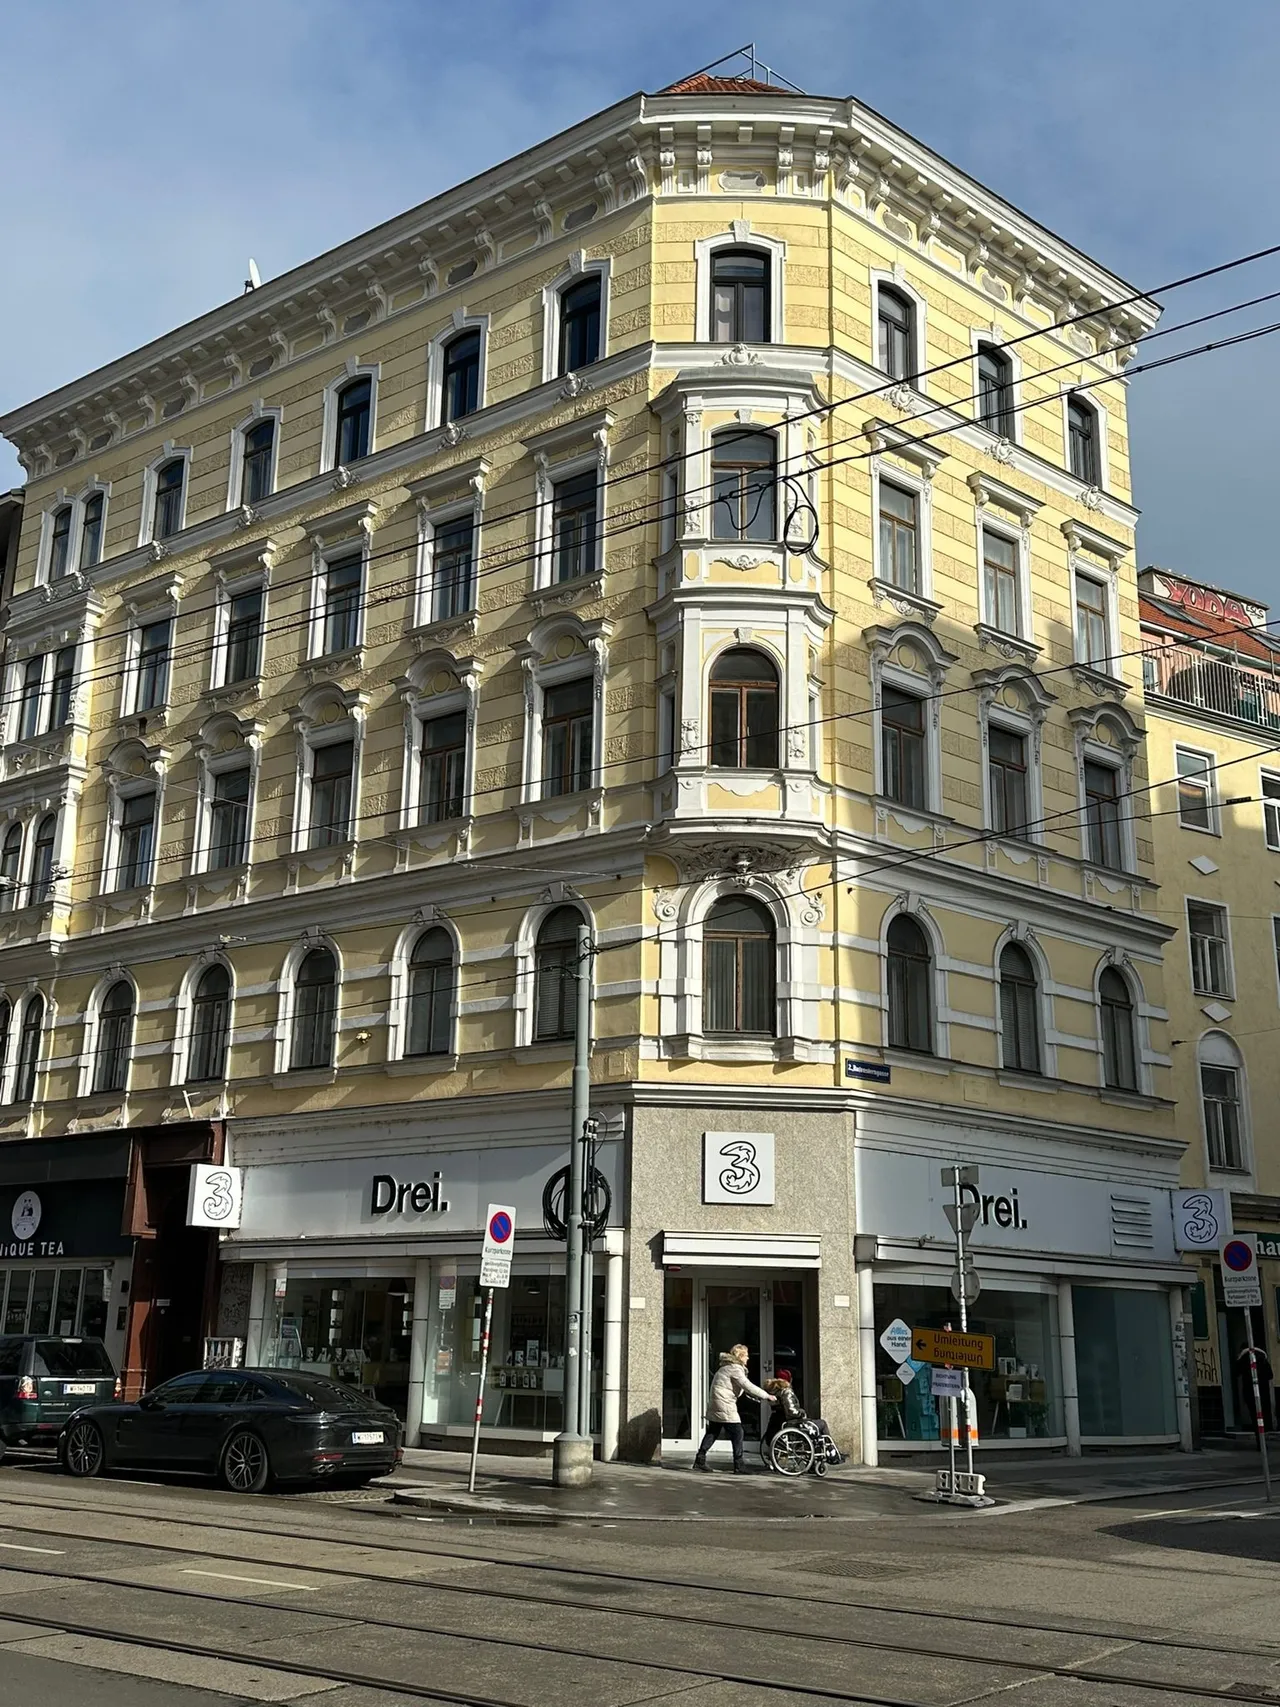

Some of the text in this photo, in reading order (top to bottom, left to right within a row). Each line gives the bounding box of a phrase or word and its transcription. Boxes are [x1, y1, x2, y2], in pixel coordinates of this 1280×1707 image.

[719, 1141, 760, 1195] 3
[203, 1171, 234, 1221] 3
[371, 1171, 450, 1216] Drei.
[1182, 1194, 1218, 1243] 3
[41, 1241, 64, 1255] TEA
[934, 1333, 984, 1351] Umleitung
[934, 1347, 983, 1365] Umleitung
